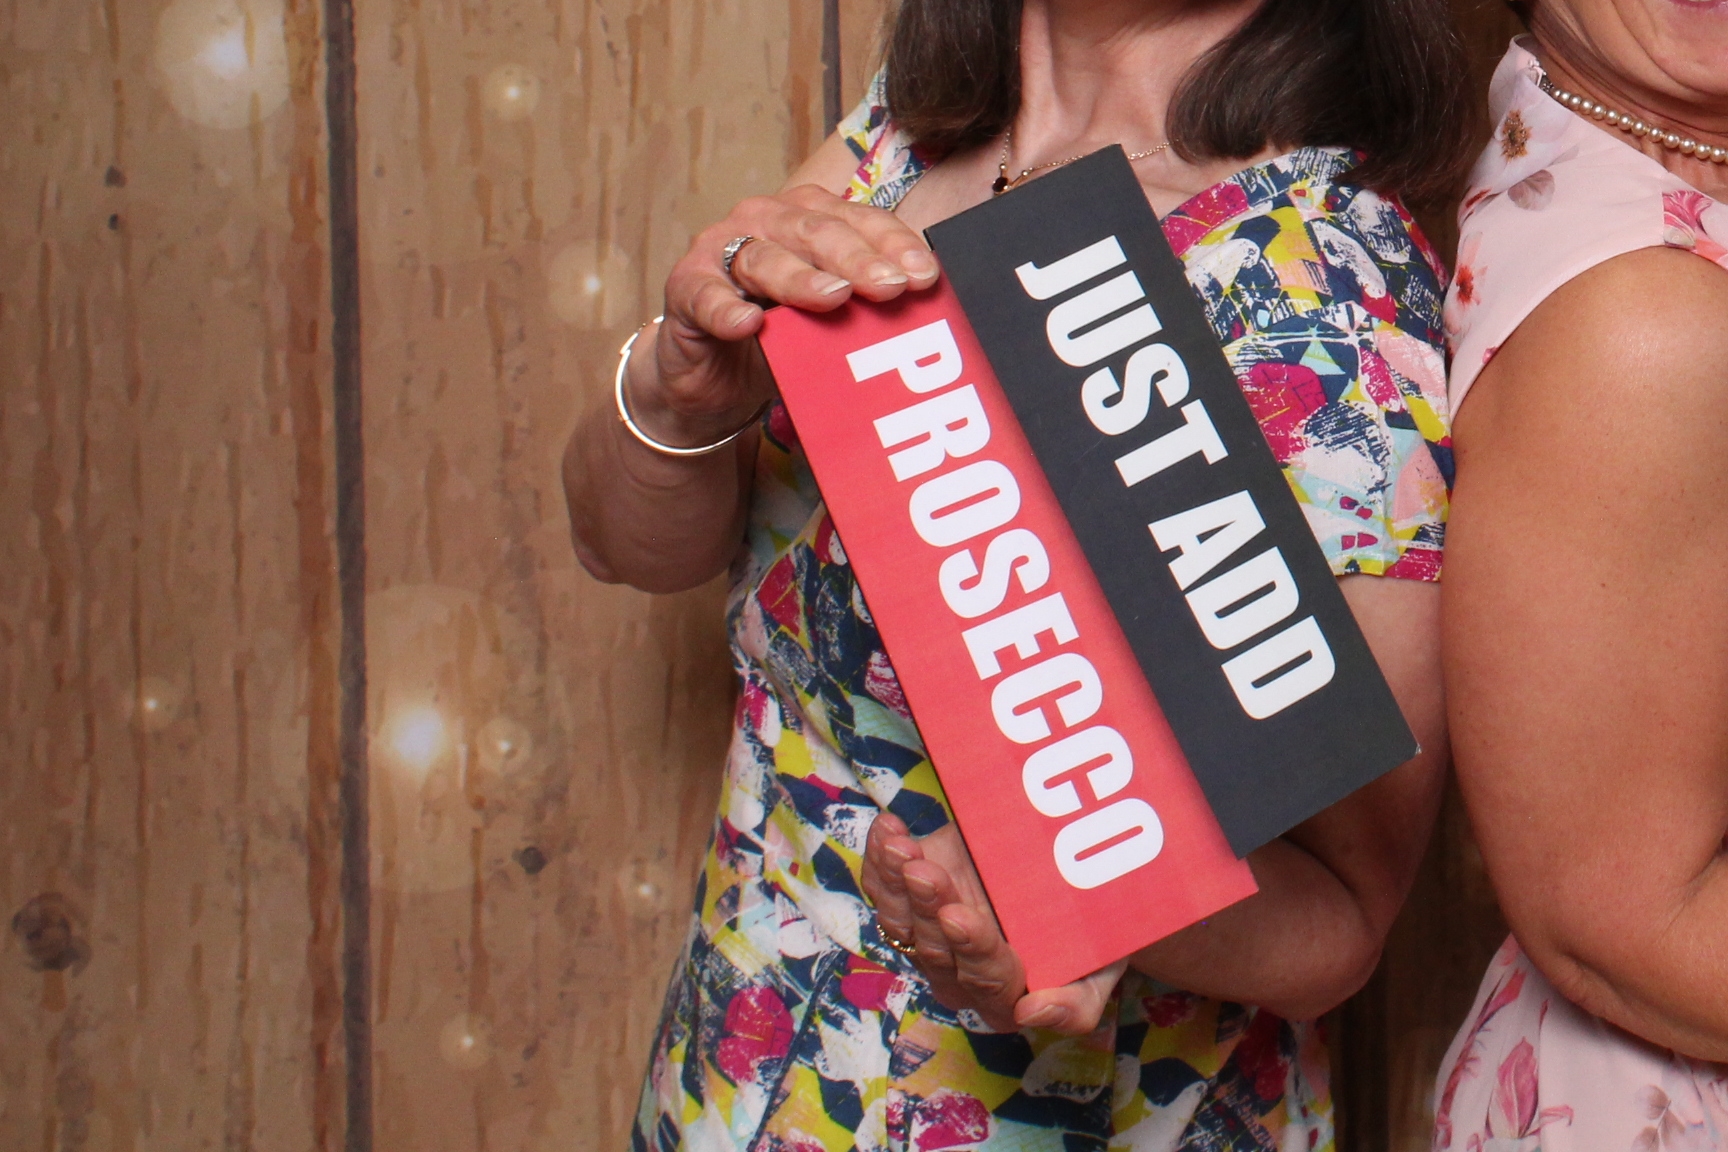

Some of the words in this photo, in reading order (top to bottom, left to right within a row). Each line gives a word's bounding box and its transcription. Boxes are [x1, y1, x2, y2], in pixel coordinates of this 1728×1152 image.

[845, 318, 1164, 890] PROSECCO
[1014, 235, 1229, 487] JUST
[1147, 490, 1335, 720] ADD
